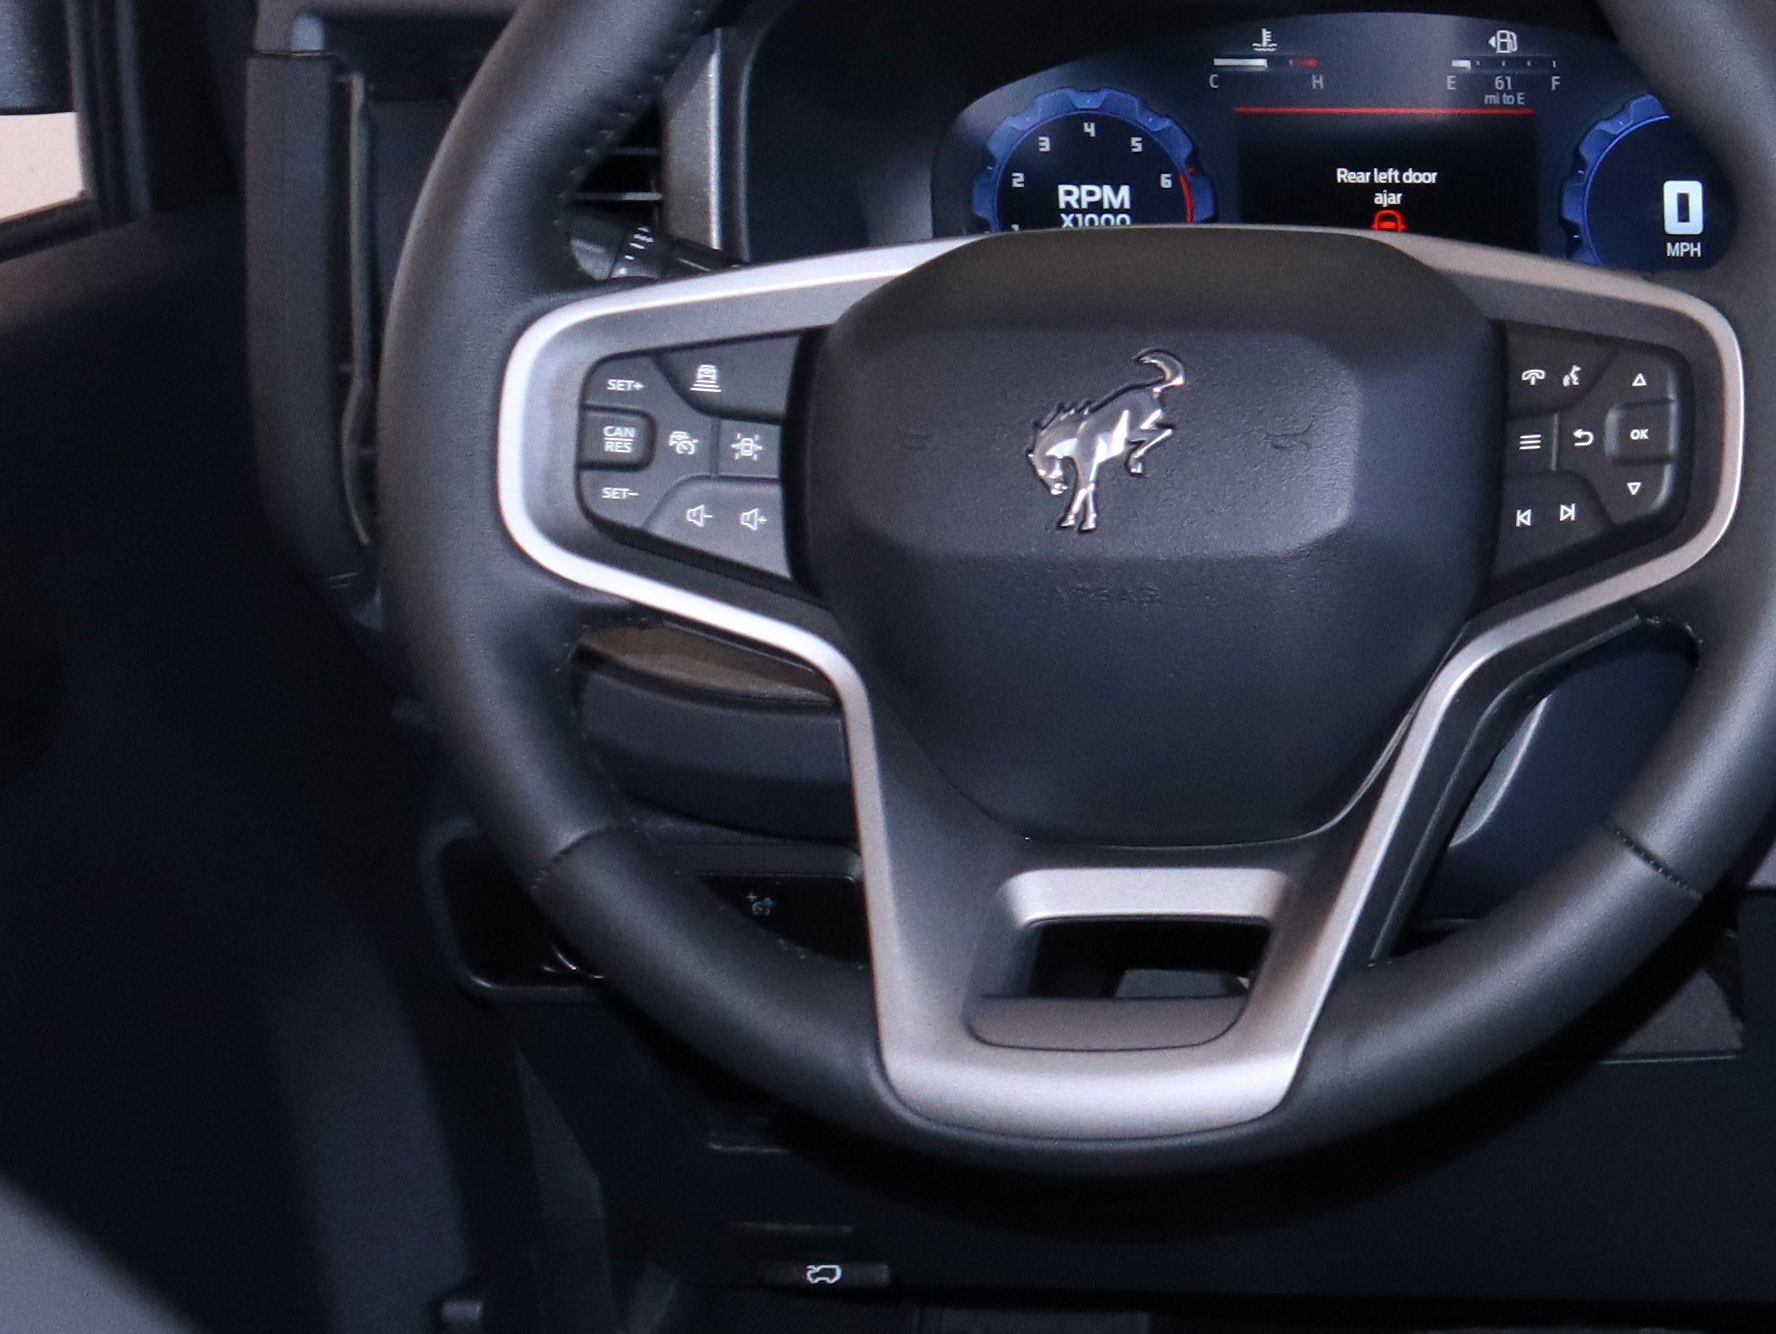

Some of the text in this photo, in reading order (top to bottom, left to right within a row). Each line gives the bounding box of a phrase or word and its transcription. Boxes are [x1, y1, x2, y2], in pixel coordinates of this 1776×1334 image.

[1209, 74, 1219, 89] C
[1312, 75, 1324, 90] H
[1447, 76, 1456, 90] E
[1494, 76, 1513, 90] 61
[1552, 76, 1561, 91] F
[1083, 122, 1096, 137] 4
[1038, 136, 1051, 152] 3
[1131, 137, 1143, 152] 5
[1012, 172, 1025, 188] 2
[1160, 173, 1172, 189] 6
[1336, 168, 1437, 184] Rear left door
[1058, 185, 1131, 209] RPM
[1374, 191, 1402, 207] ajar
[1663, 180, 1703, 235] 0
[1666, 241, 1701, 257] MPH
[603, 426, 635, 438] CAN
[1630, 429, 1649, 440] OK
[604, 441, 631, 453] RES
